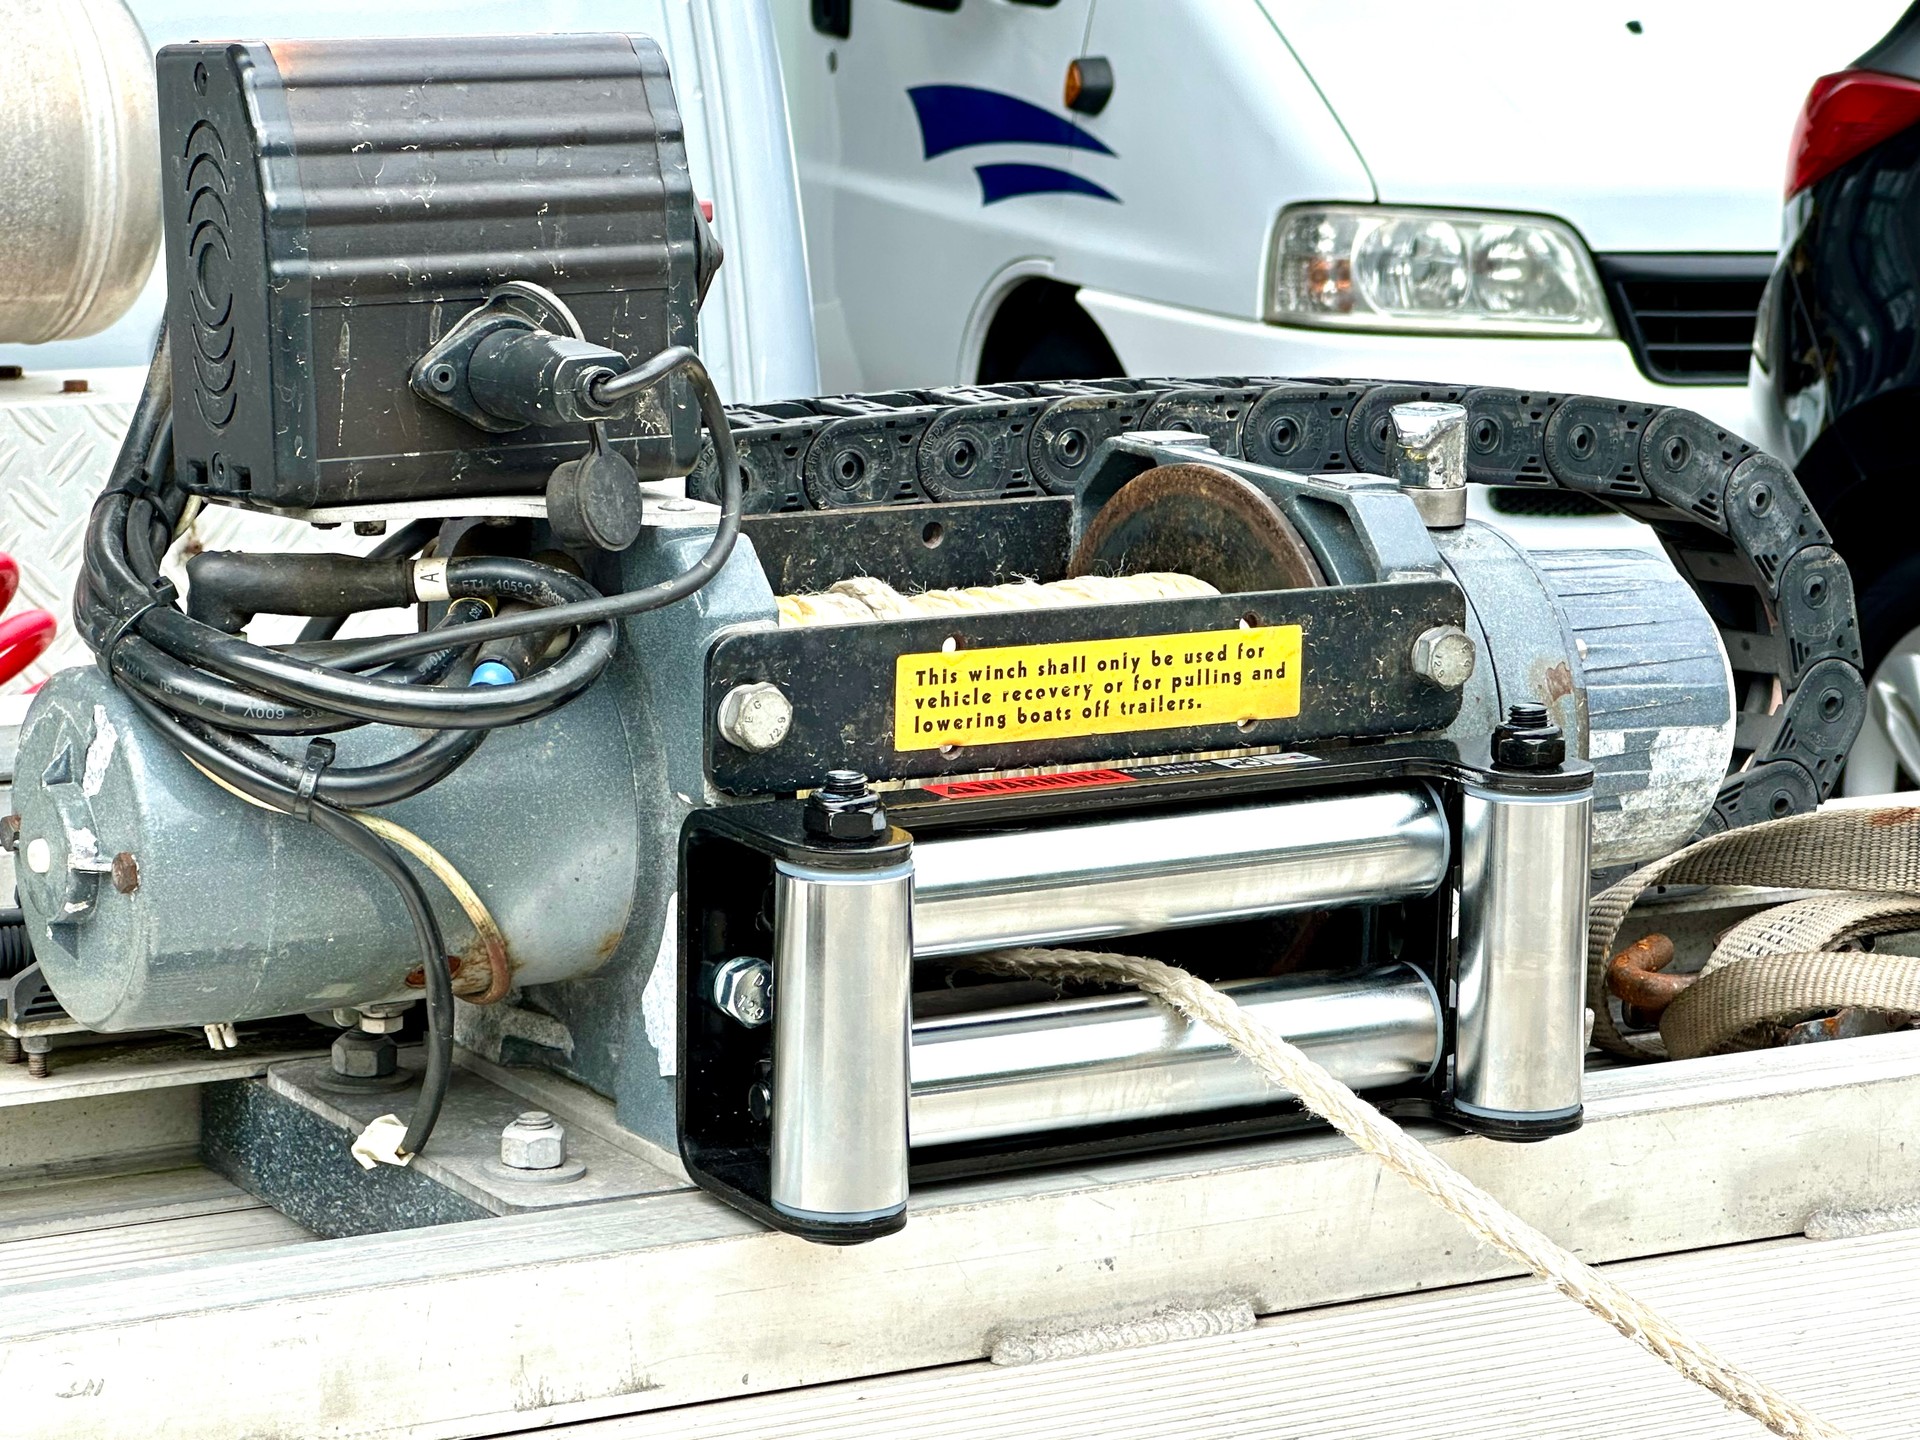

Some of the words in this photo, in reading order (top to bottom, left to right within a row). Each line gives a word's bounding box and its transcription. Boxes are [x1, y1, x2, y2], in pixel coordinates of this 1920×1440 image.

[420, 572, 440, 583] A
[916, 665, 957, 686] This
[968, 660, 1027, 682] winch
[1038, 655, 1086, 676] shall
[1097, 652, 1141, 674] only
[1151, 649, 1174, 667] be
[1184, 643, 1227, 665] used
[1237, 642, 1265, 660] for
[915, 687, 992, 710] vehicle
[1002, 683, 1093, 704] recovery
[1103, 681, 1123, 694] or
[1133, 674, 1161, 692] for
[1171, 668, 1242, 694] pulling
[1252, 661, 1286, 681] and
[243, 705, 285, 720] 600V
[914, 712, 1006, 734] lowering
[1017, 706, 1071, 725] boats
[1082, 699, 1110, 719] off
[1120, 694, 1203, 716] trailers.
[974, 771, 1117, 791] WARNING
